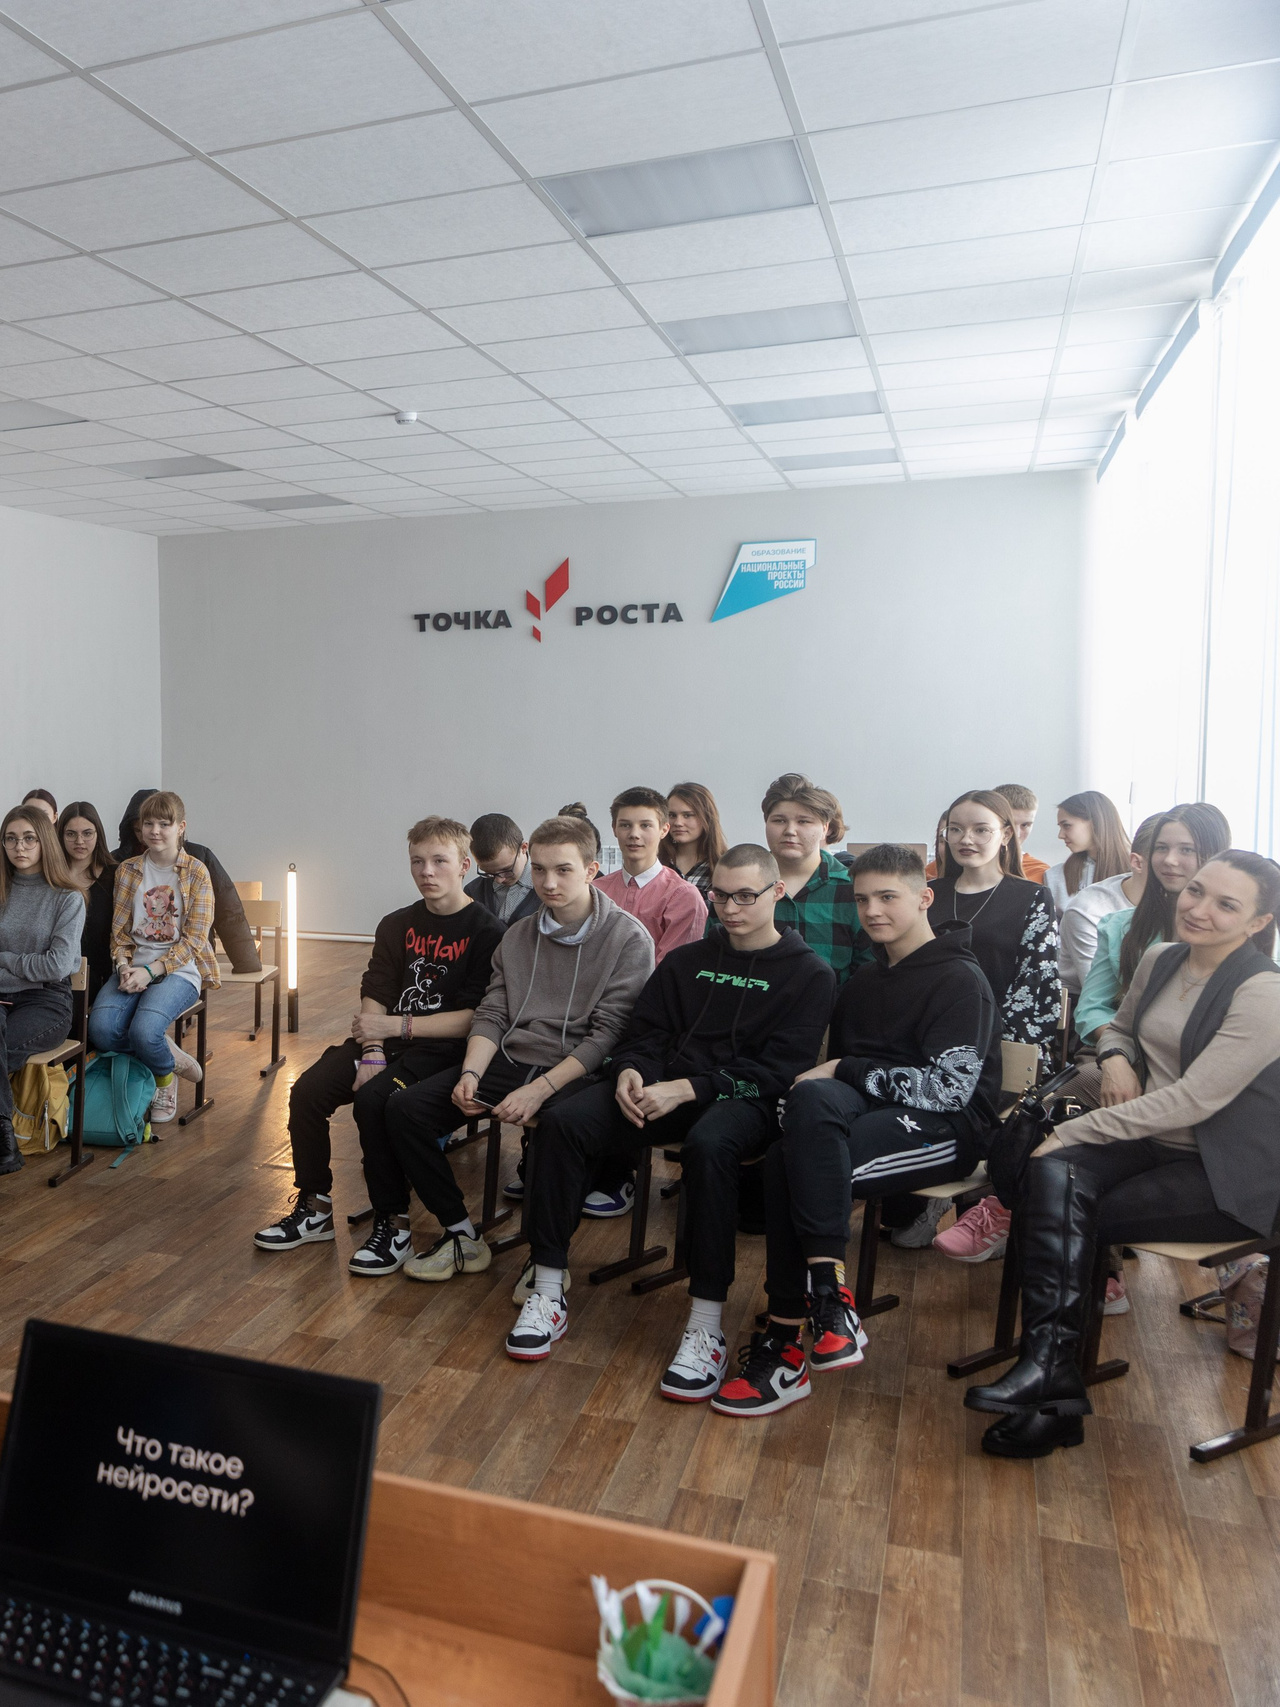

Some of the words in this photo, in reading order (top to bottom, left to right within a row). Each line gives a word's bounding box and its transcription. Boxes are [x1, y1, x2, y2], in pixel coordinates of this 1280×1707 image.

[751, 548, 807, 557] ОБРАЗОВАНИЕ
[740, 561, 805, 573] НАЦИОНАЛЬНЫЕ
[767, 570, 805, 581] ПРОЕКТЫ
[773, 579, 805, 590] РОССИИ
[413, 609, 512, 633] ТОЧКА
[575, 602, 684, 627] РОСТА
[405, 927, 470, 962] Outlaw
[116, 1425, 163, 1462] Что
[168, 1442, 245, 1480] такое
[96, 1461, 256, 1518] нейросети?
